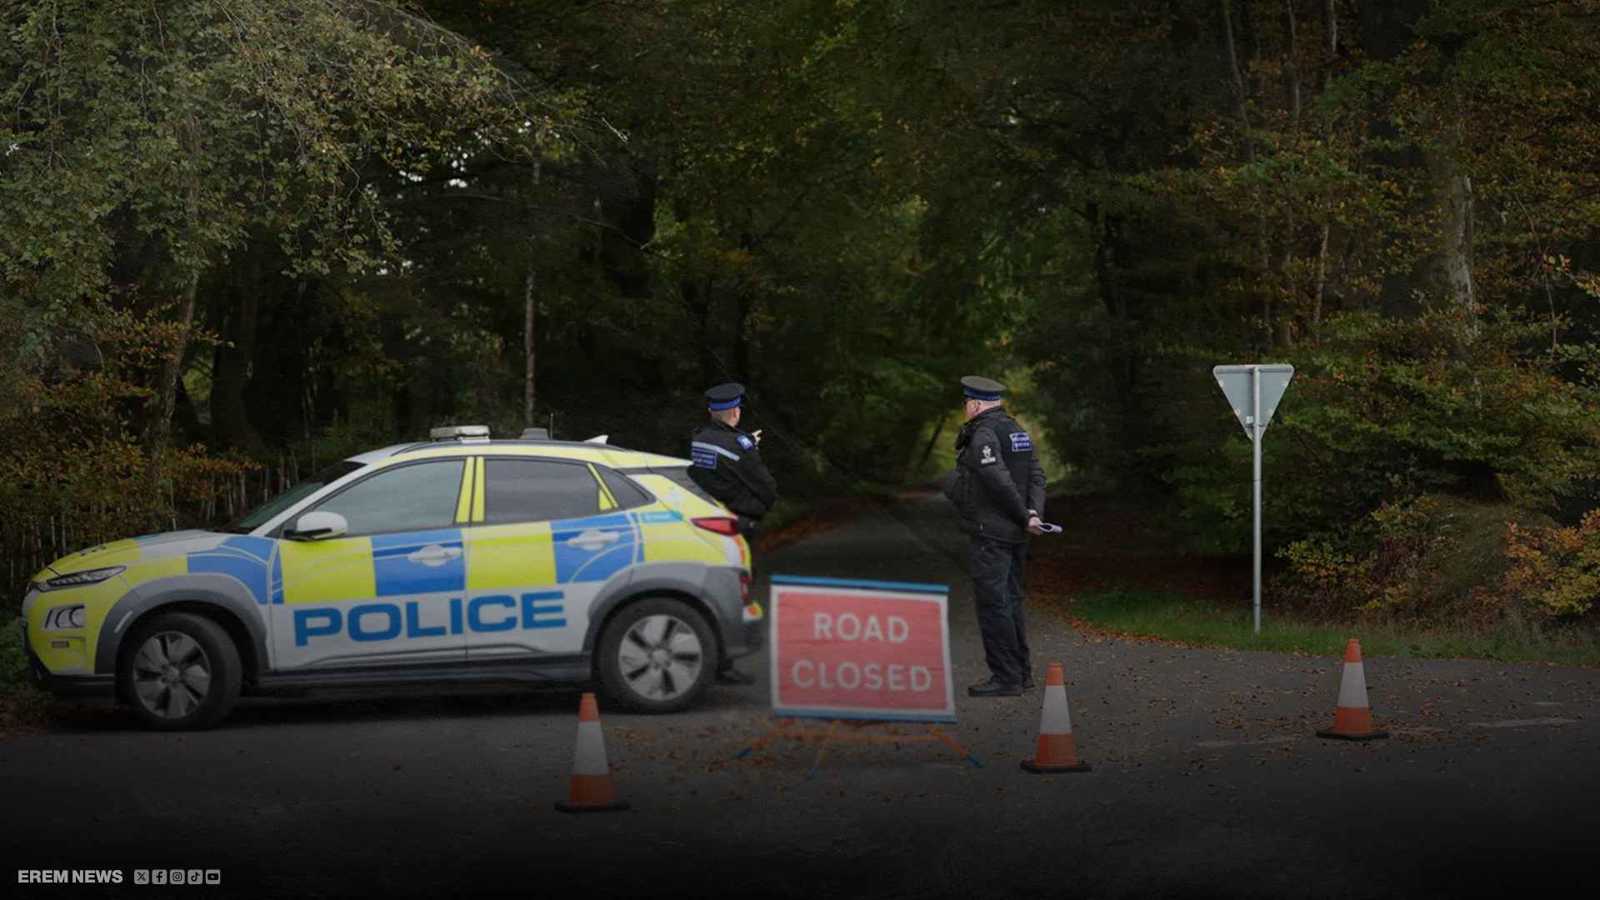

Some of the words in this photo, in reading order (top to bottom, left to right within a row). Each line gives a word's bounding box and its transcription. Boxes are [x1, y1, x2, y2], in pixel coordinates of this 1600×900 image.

[293, 591, 567, 647] POLICE
[813, 612, 909, 643] ROAD
[791, 658, 932, 692] CLOSED
